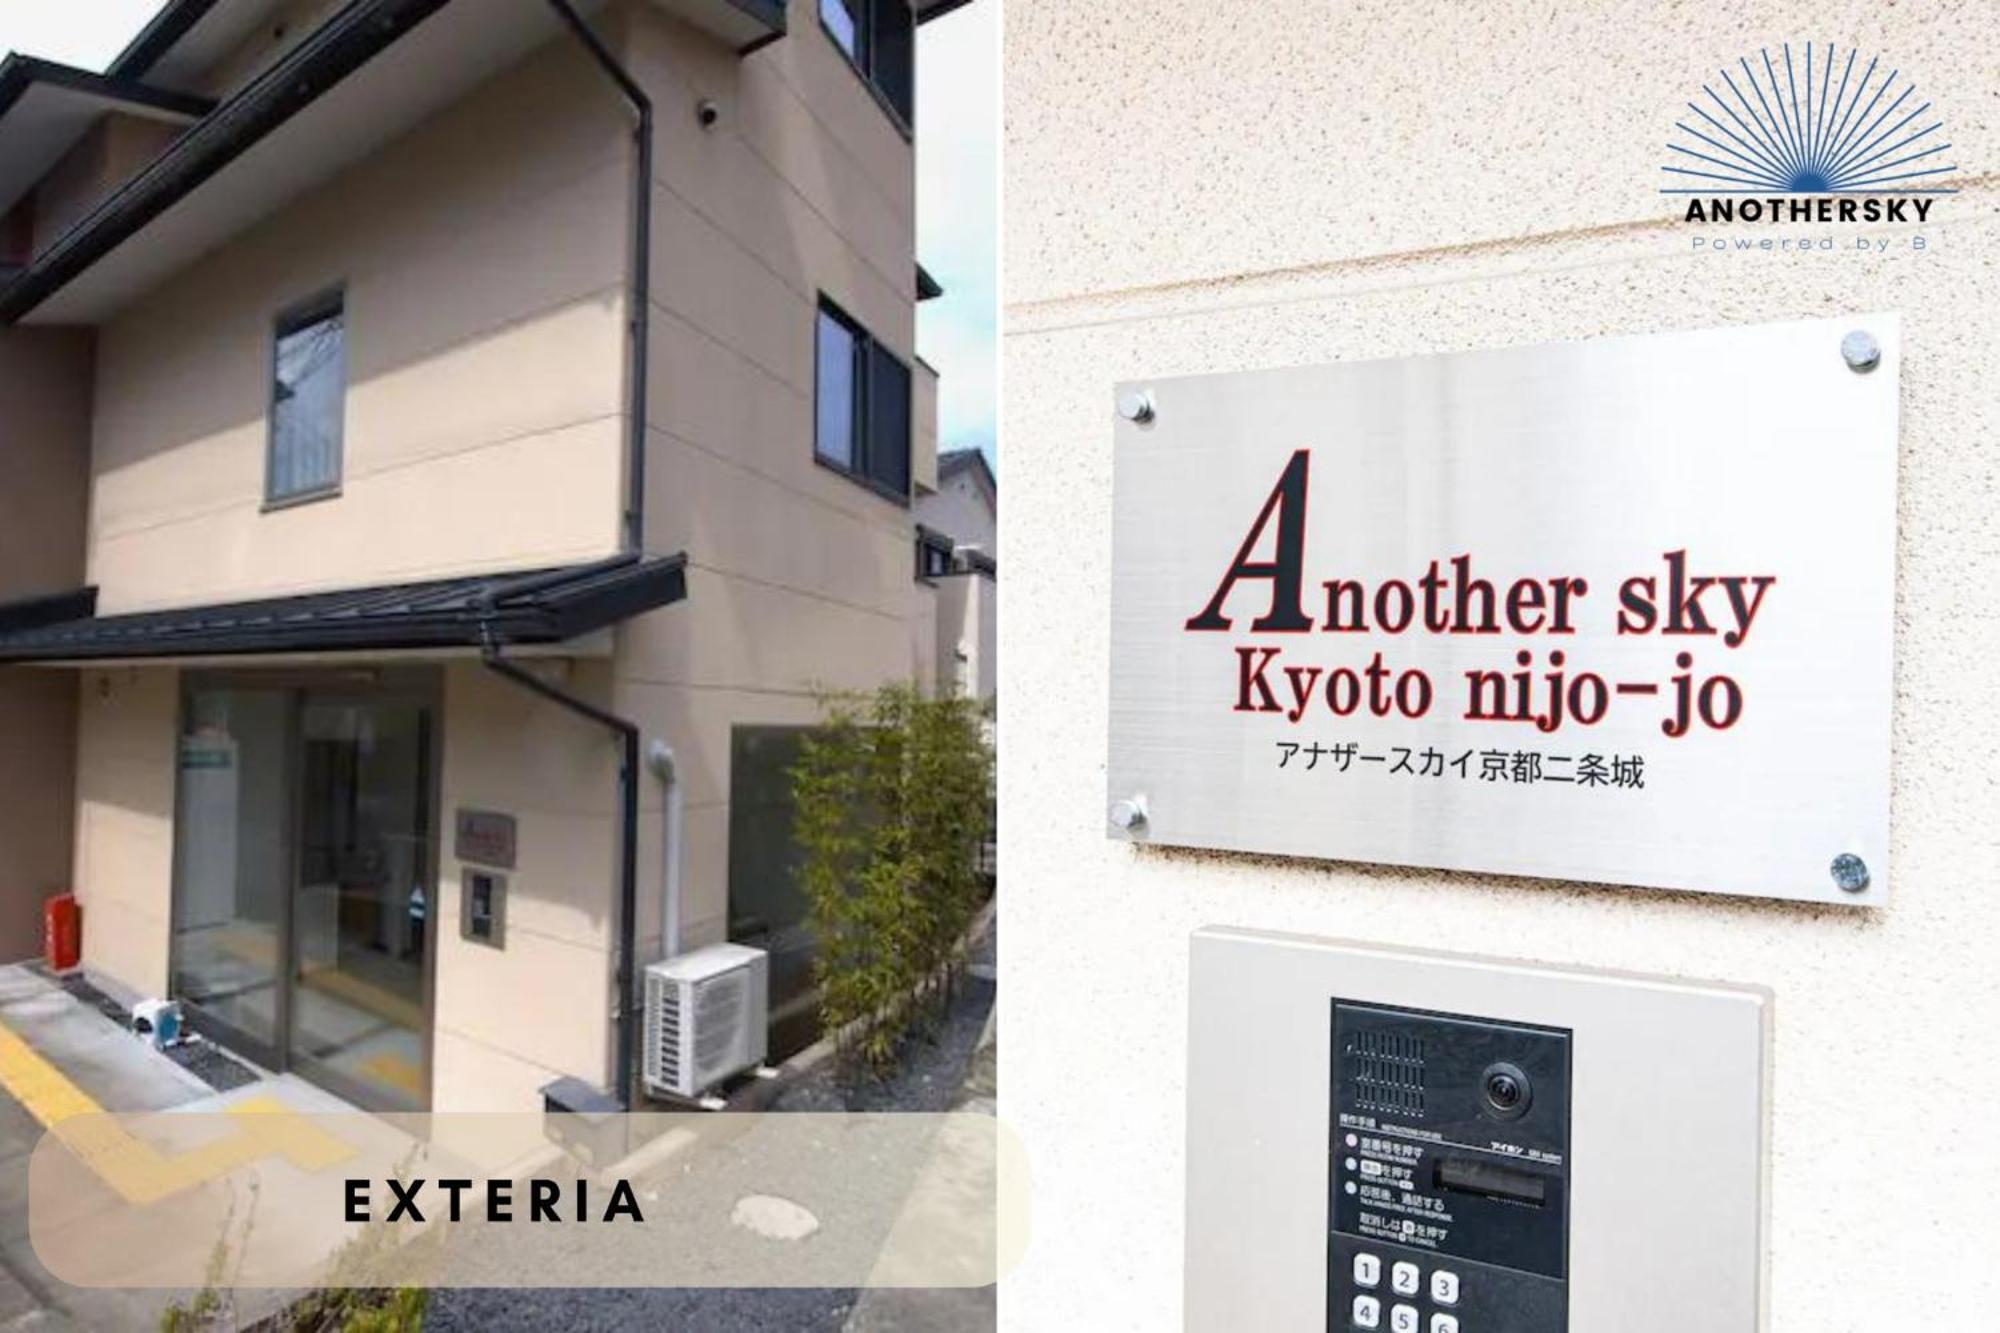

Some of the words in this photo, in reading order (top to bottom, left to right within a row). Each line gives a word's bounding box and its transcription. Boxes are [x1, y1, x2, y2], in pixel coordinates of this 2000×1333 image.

[1185, 449, 1588, 635] Another
[1617, 549, 1776, 648] sky
[1233, 646, 1433, 724] Kyoto
[1275, 741, 1646, 790] アナザースカイ京都二条城
[1361, 1262, 1370, 1279] 1
[1399, 1270, 1411, 1288] 2
[1438, 1279, 1450, 1297] 3
[1360, 1304, 1372, 1321] 4
[1399, 1313, 1410, 1330] 5
